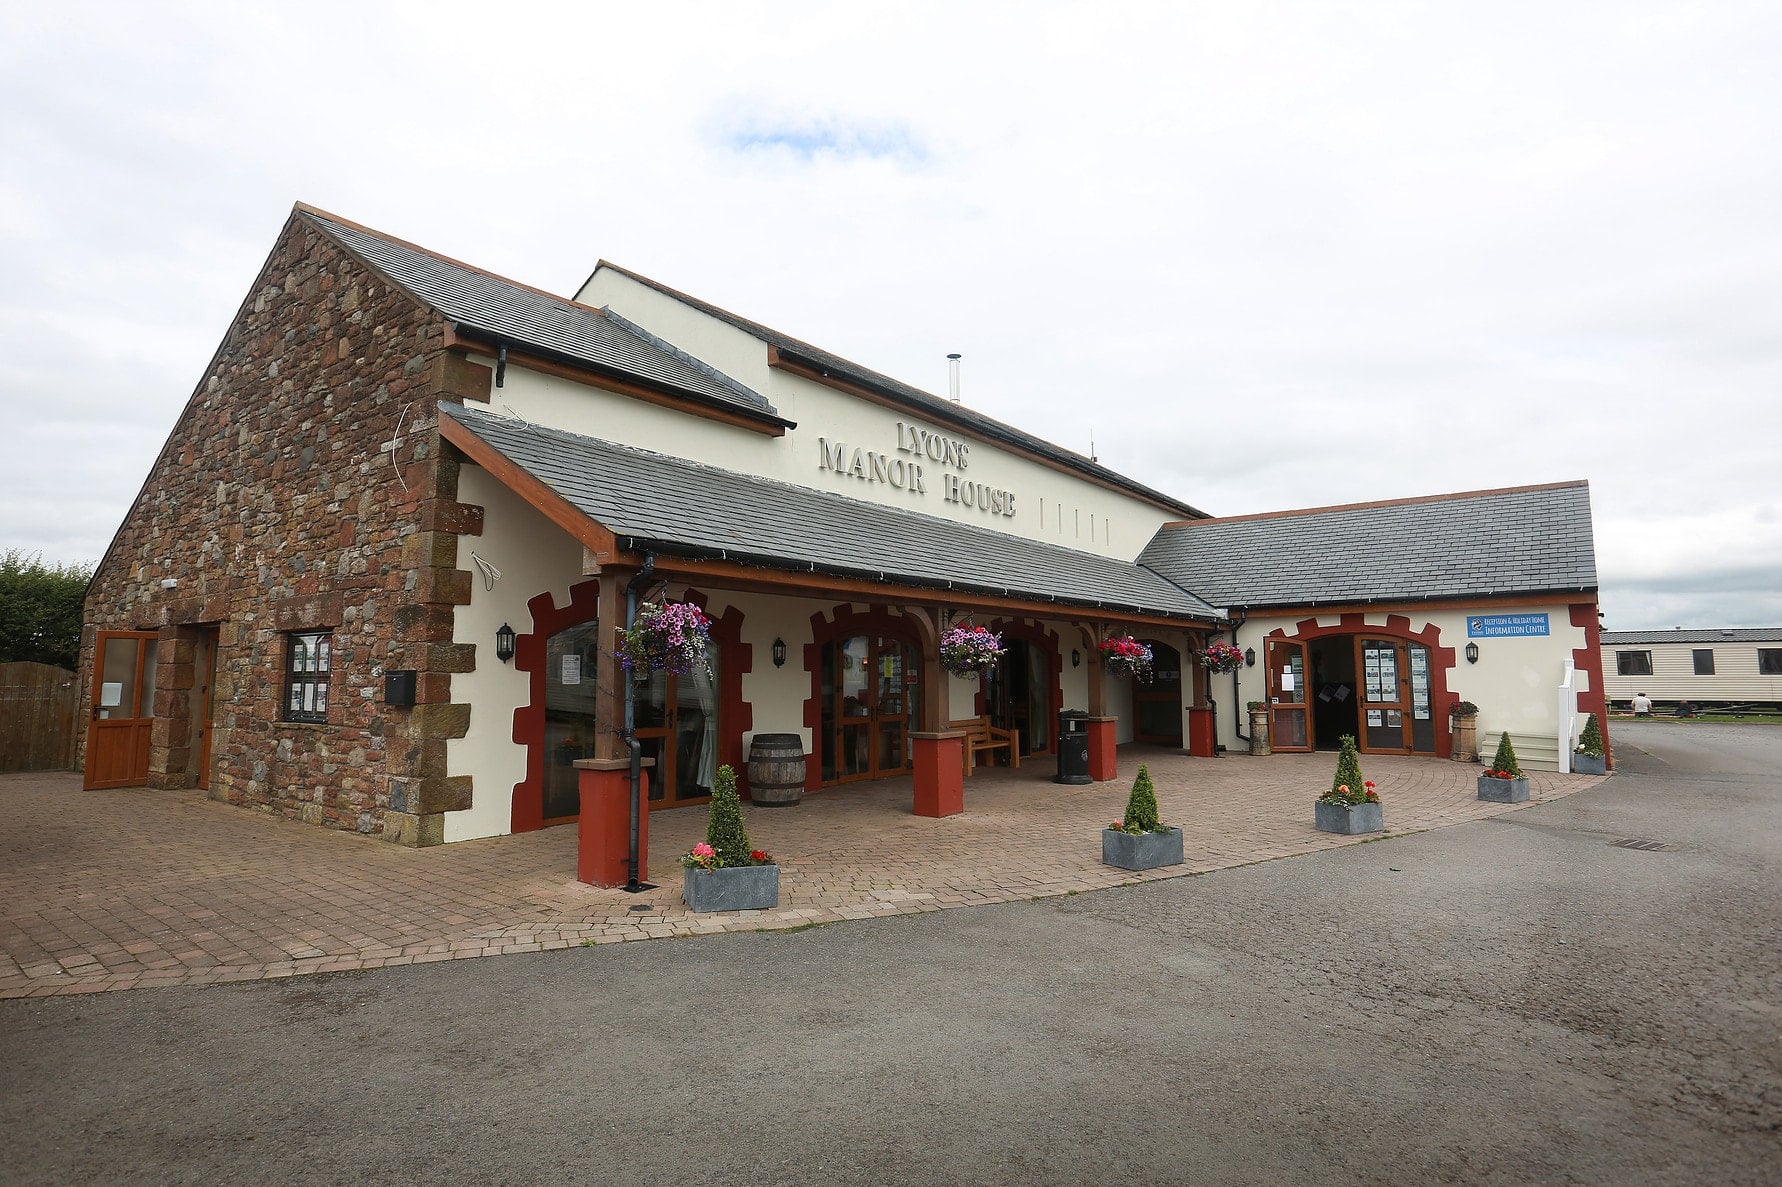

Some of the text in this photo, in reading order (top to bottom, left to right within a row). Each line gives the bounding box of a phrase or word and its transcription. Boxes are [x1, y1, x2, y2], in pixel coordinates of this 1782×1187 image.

[897, 422, 970, 469] LYONS
[818, 437, 1016, 517] MANOR HOUSE
[1485, 626, 1524, 635] INFORMATION
[1525, 625, 1546, 633] CENTRE
